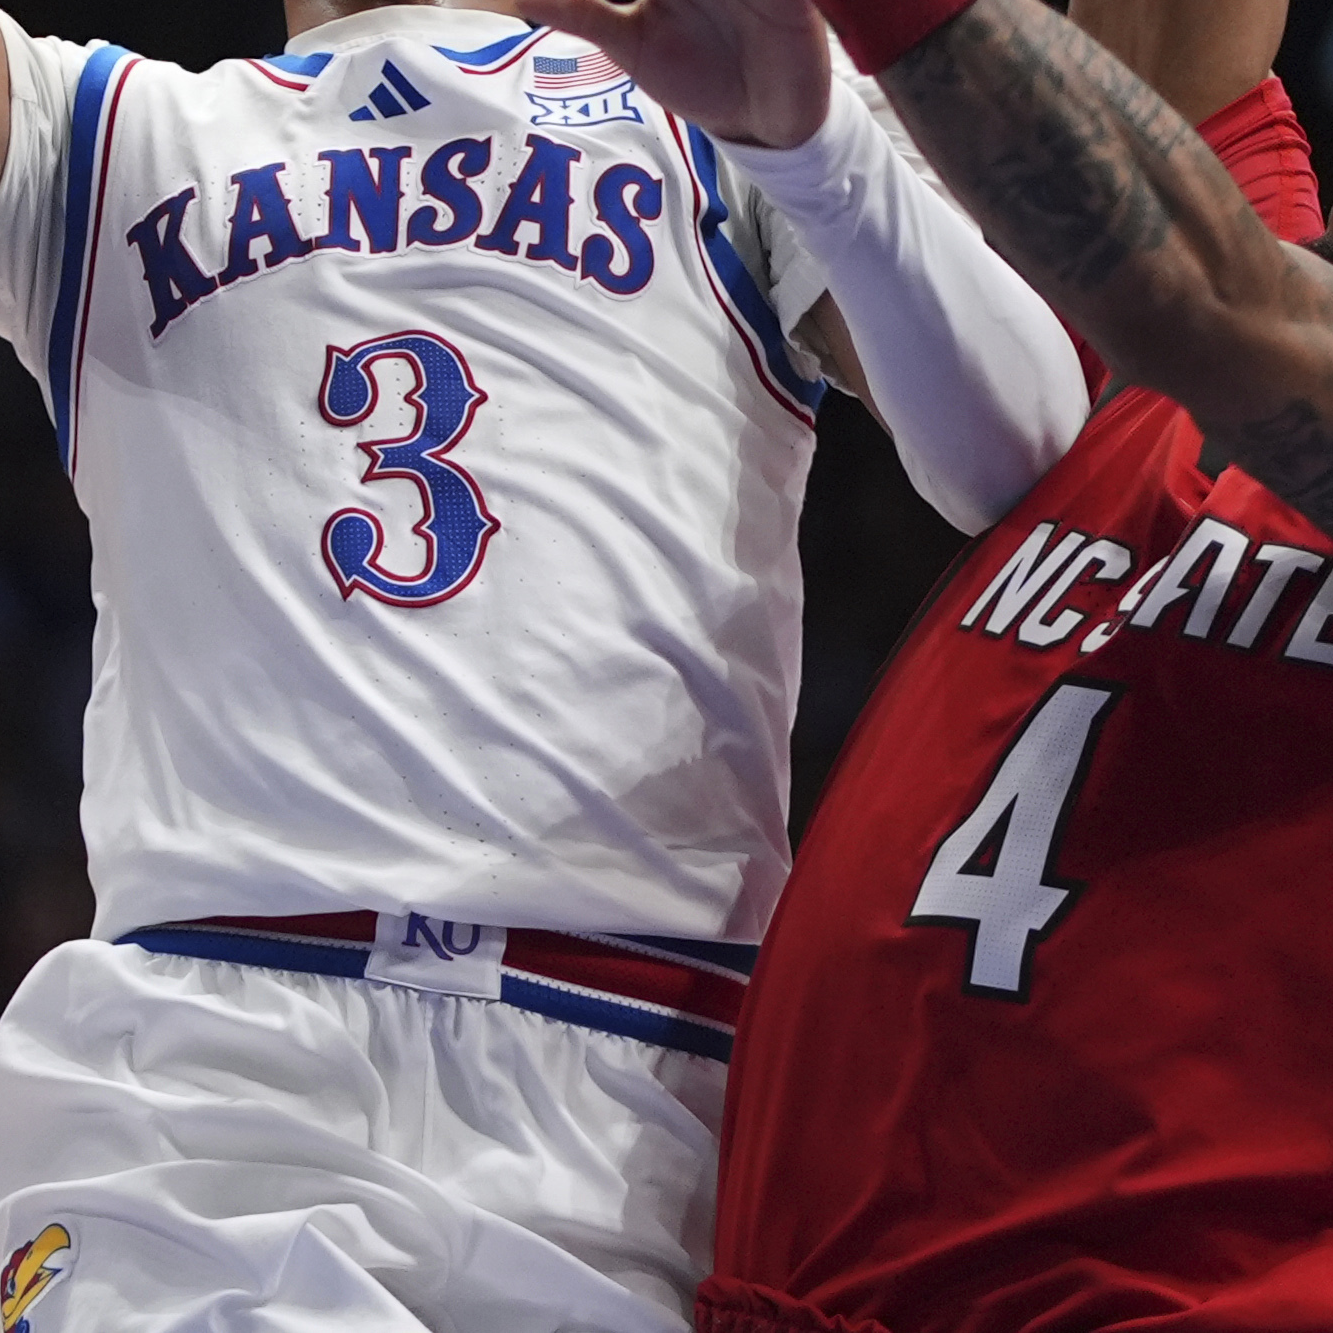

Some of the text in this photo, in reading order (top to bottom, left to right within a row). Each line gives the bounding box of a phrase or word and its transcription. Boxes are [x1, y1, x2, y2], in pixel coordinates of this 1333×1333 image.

[524, 78, 644, 126] XII
[127, 133, 663, 340] KANSAS
[319, 330, 501, 607] 3
[958, 519, 1134, 649] NC
[905, 679, 1121, 998] 4
[401, 911, 481, 961] KU
